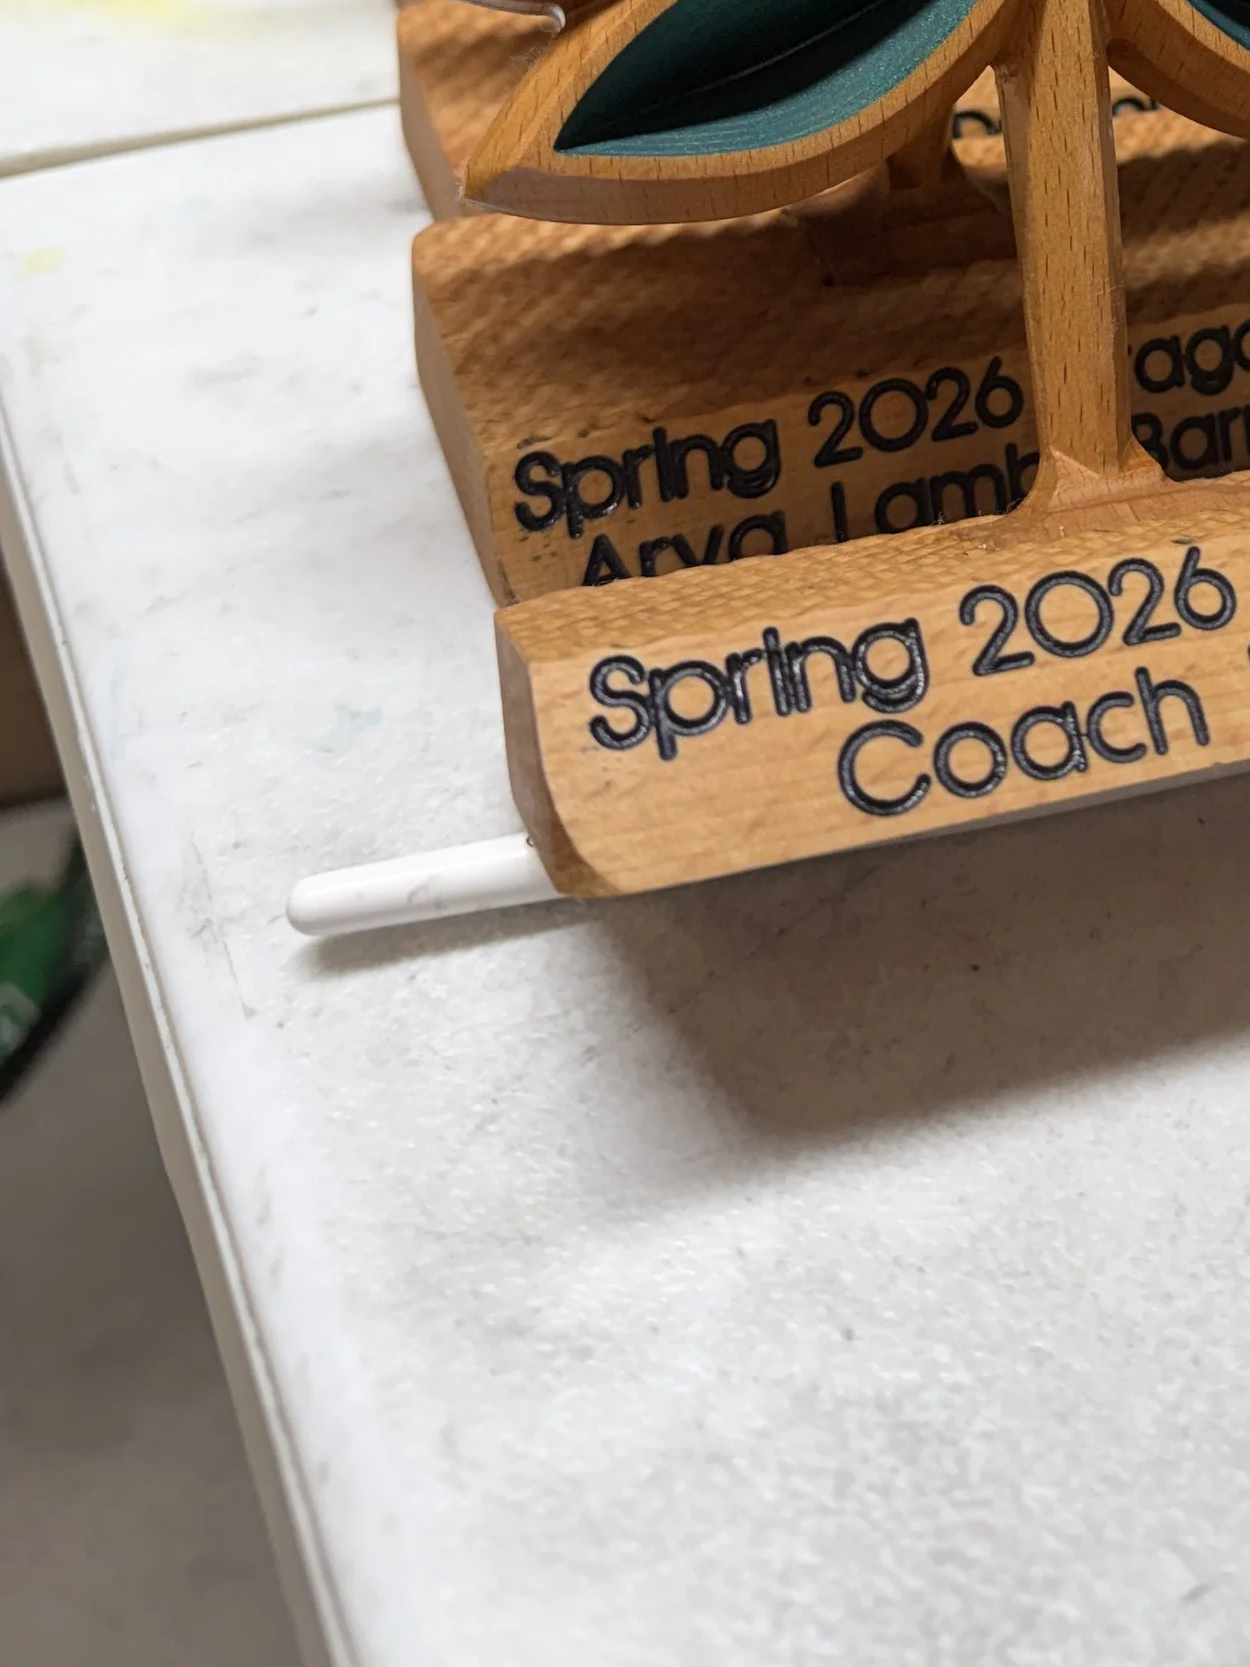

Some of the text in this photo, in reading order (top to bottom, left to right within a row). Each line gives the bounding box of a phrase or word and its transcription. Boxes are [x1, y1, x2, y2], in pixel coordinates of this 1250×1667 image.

[514, 418, 781, 538] Spring
[808, 356, 1024, 468] 2026
[589, 618, 929, 760] Spring
[959, 546, 1237, 676] 2026
[838, 667, 1210, 816] Coach
